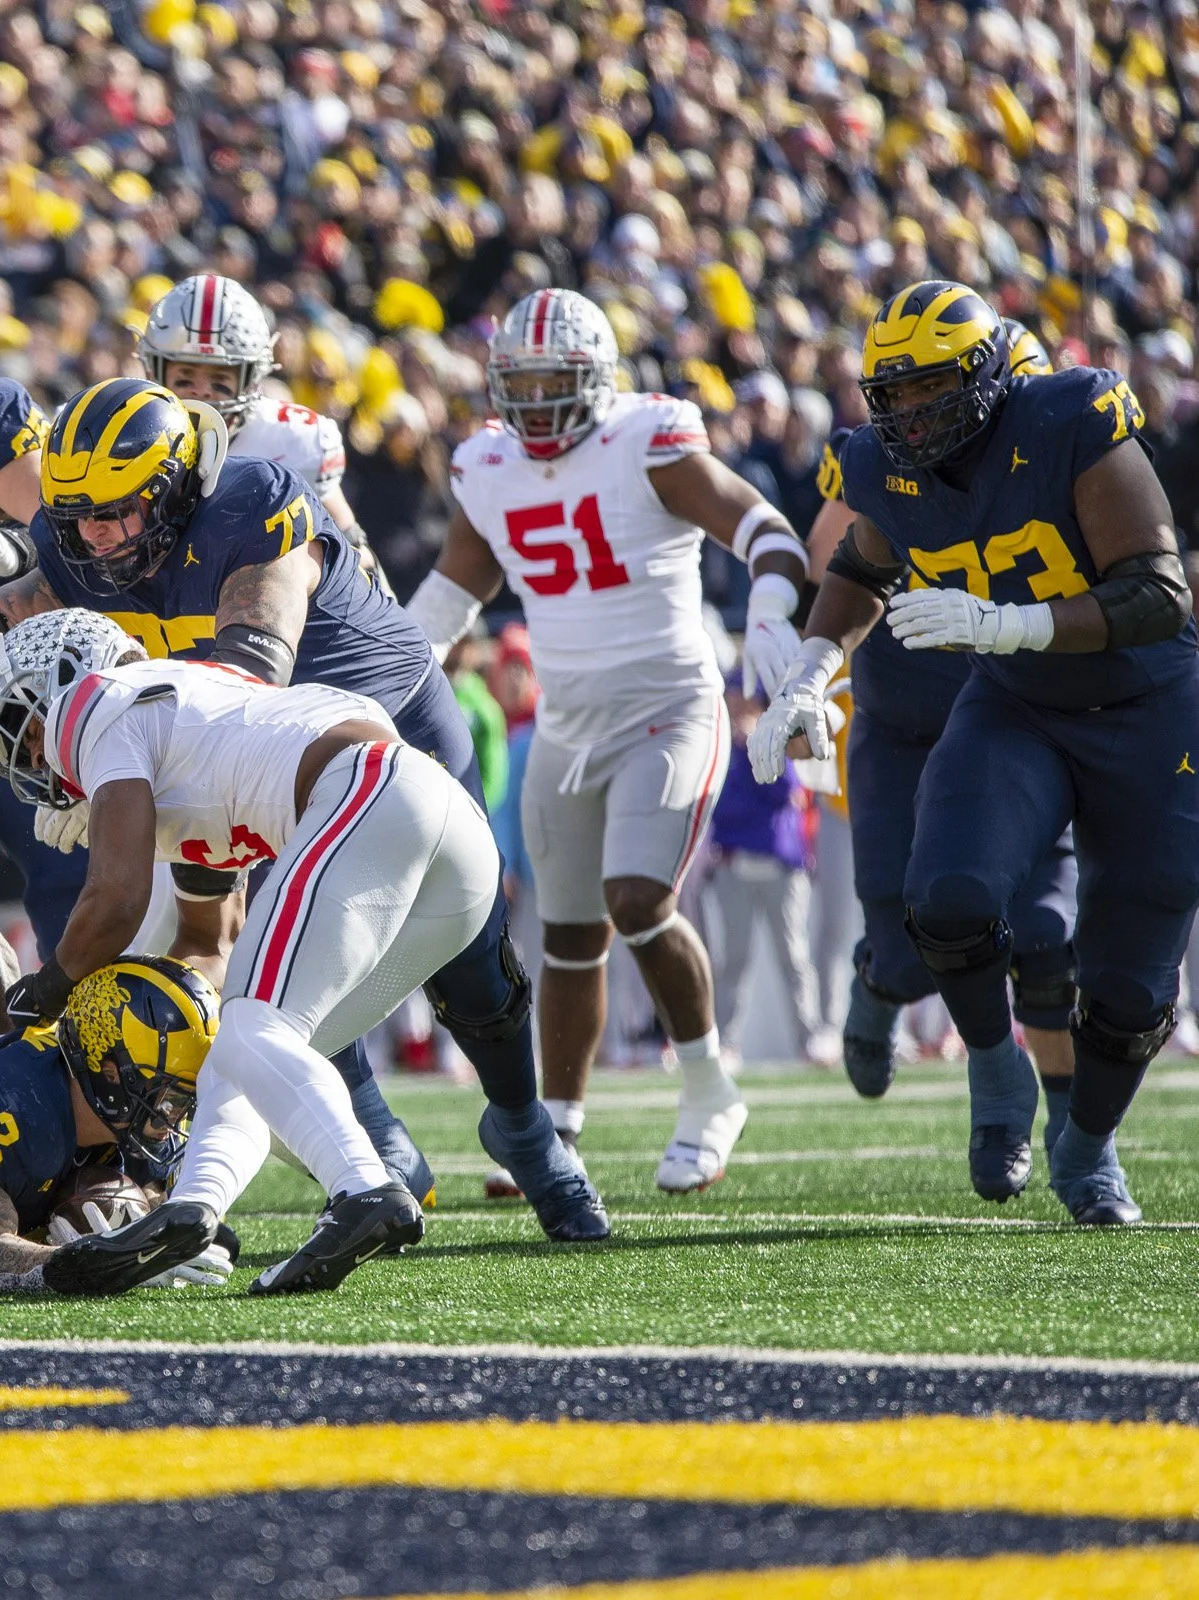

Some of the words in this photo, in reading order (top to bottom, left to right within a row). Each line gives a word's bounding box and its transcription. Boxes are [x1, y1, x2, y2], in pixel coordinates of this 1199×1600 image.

[1092, 380, 1145, 441] 73
[265, 494, 315, 557] 77
[505, 493, 631, 596] 51
[908, 519, 1090, 603] 73
